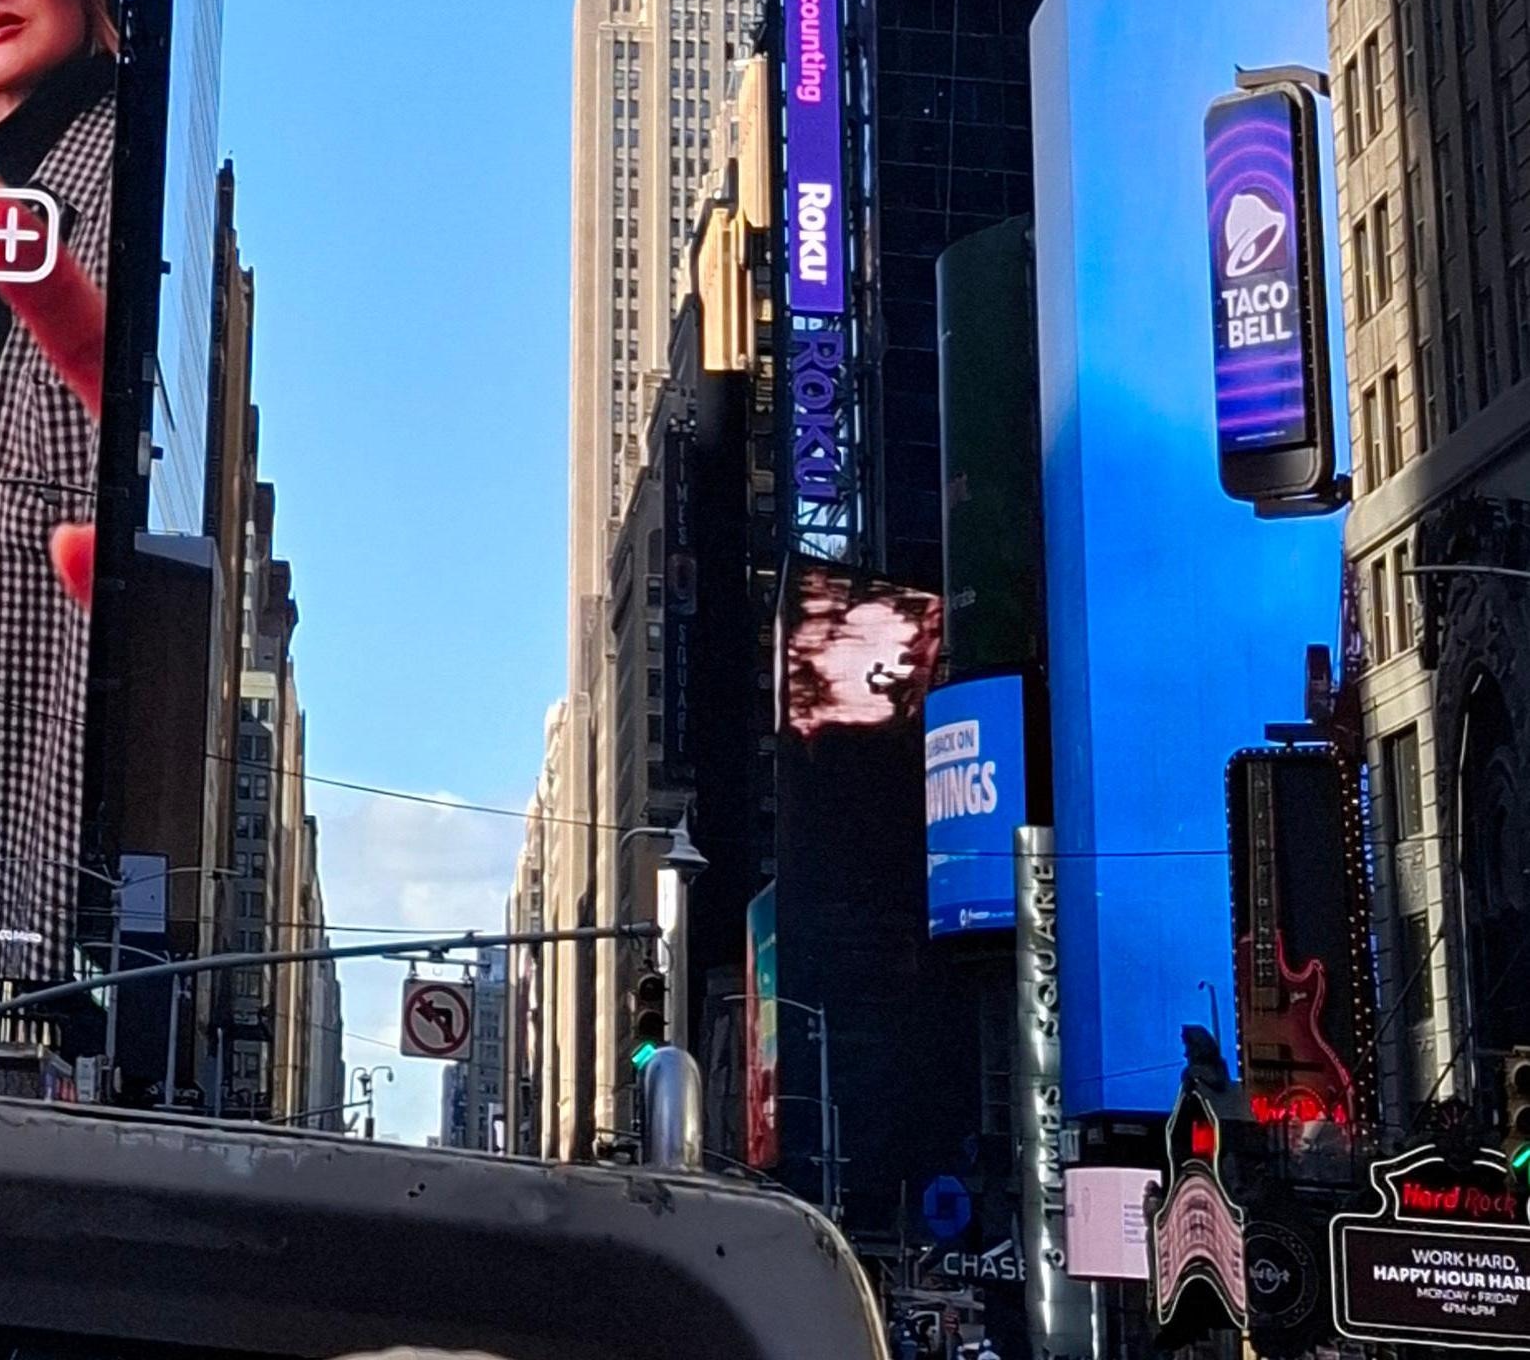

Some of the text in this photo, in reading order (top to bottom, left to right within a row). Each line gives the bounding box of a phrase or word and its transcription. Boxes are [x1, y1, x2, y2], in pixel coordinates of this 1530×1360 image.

[1221, 280, 1290, 315] TACO
[1227, 313, 1293, 349] BELL
[1033, 857, 1058, 1038] SQUARE
[1404, 1183, 1461, 1212] Hard
[1412, 1249, 1520, 1273] WORK HARD,
[1373, 1265, 1430, 1283] HAPPY
[1435, 1270, 1486, 1288] HOUR
[1417, 1287, 1470, 1302] MONDAY
[1478, 1291, 1520, 1306] FRIDAY
